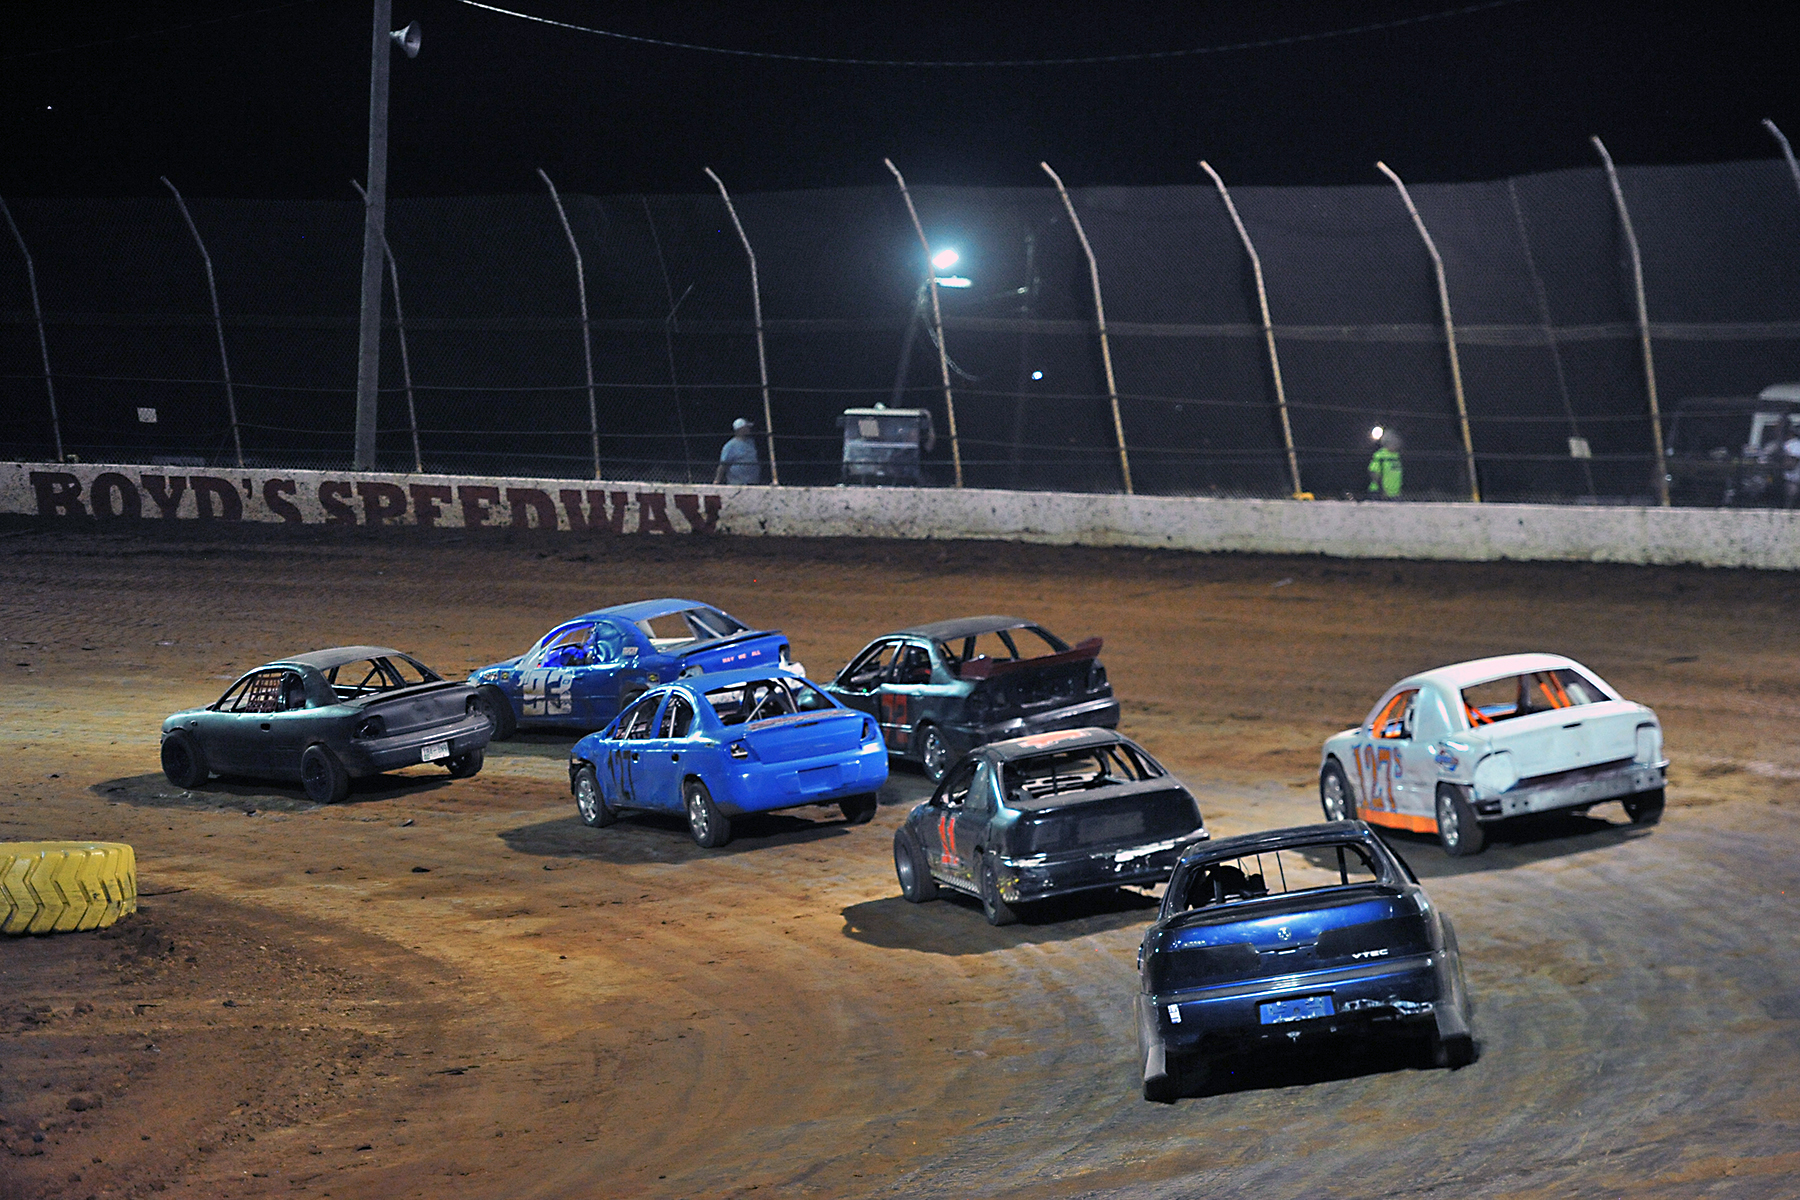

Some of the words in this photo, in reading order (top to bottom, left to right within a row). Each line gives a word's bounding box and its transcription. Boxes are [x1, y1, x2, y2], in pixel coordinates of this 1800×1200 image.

[318, 480, 722, 534] SPEEDWAY
[522, 669, 573, 716] 93
[1351, 948, 1389, 960] VTEC
